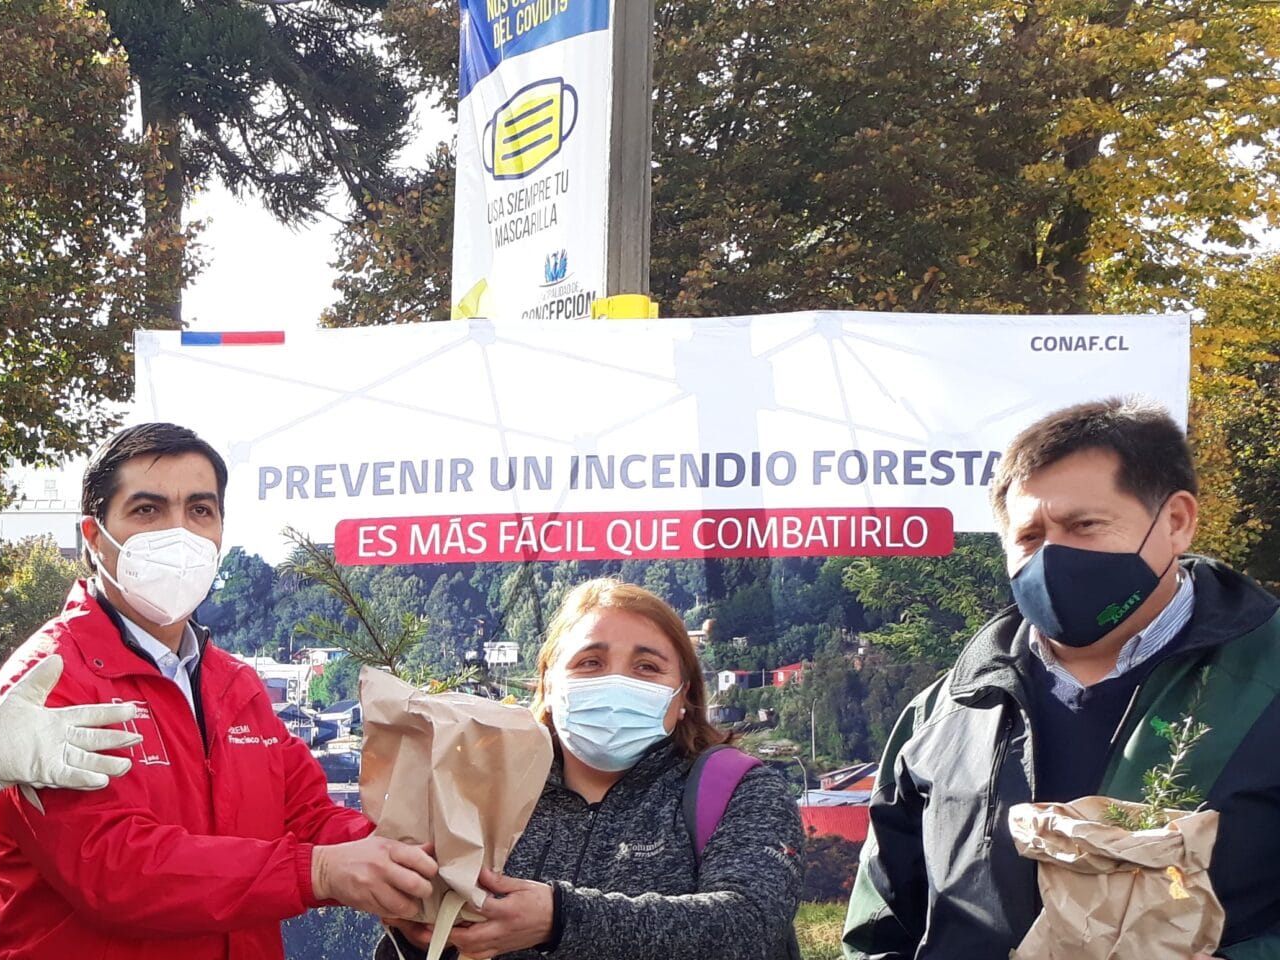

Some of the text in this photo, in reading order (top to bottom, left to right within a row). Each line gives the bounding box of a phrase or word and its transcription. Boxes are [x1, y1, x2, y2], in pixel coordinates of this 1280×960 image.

[493, 17, 513, 48] DEL
[516, 0, 552, 36] COVID
[487, 169, 570, 224] USA SIEMPRE TU
[495, 203, 558, 248] MASCARILLA
[1030, 335, 1130, 352] CONAF.CL
[258, 457, 474, 500] PREVENIR
[489, 455, 553, 491] UN
[570, 449, 797, 491] INCENDIO
[357, 514, 930, 558] ES MÁS FÁCIL QUE COMBATIRLO
